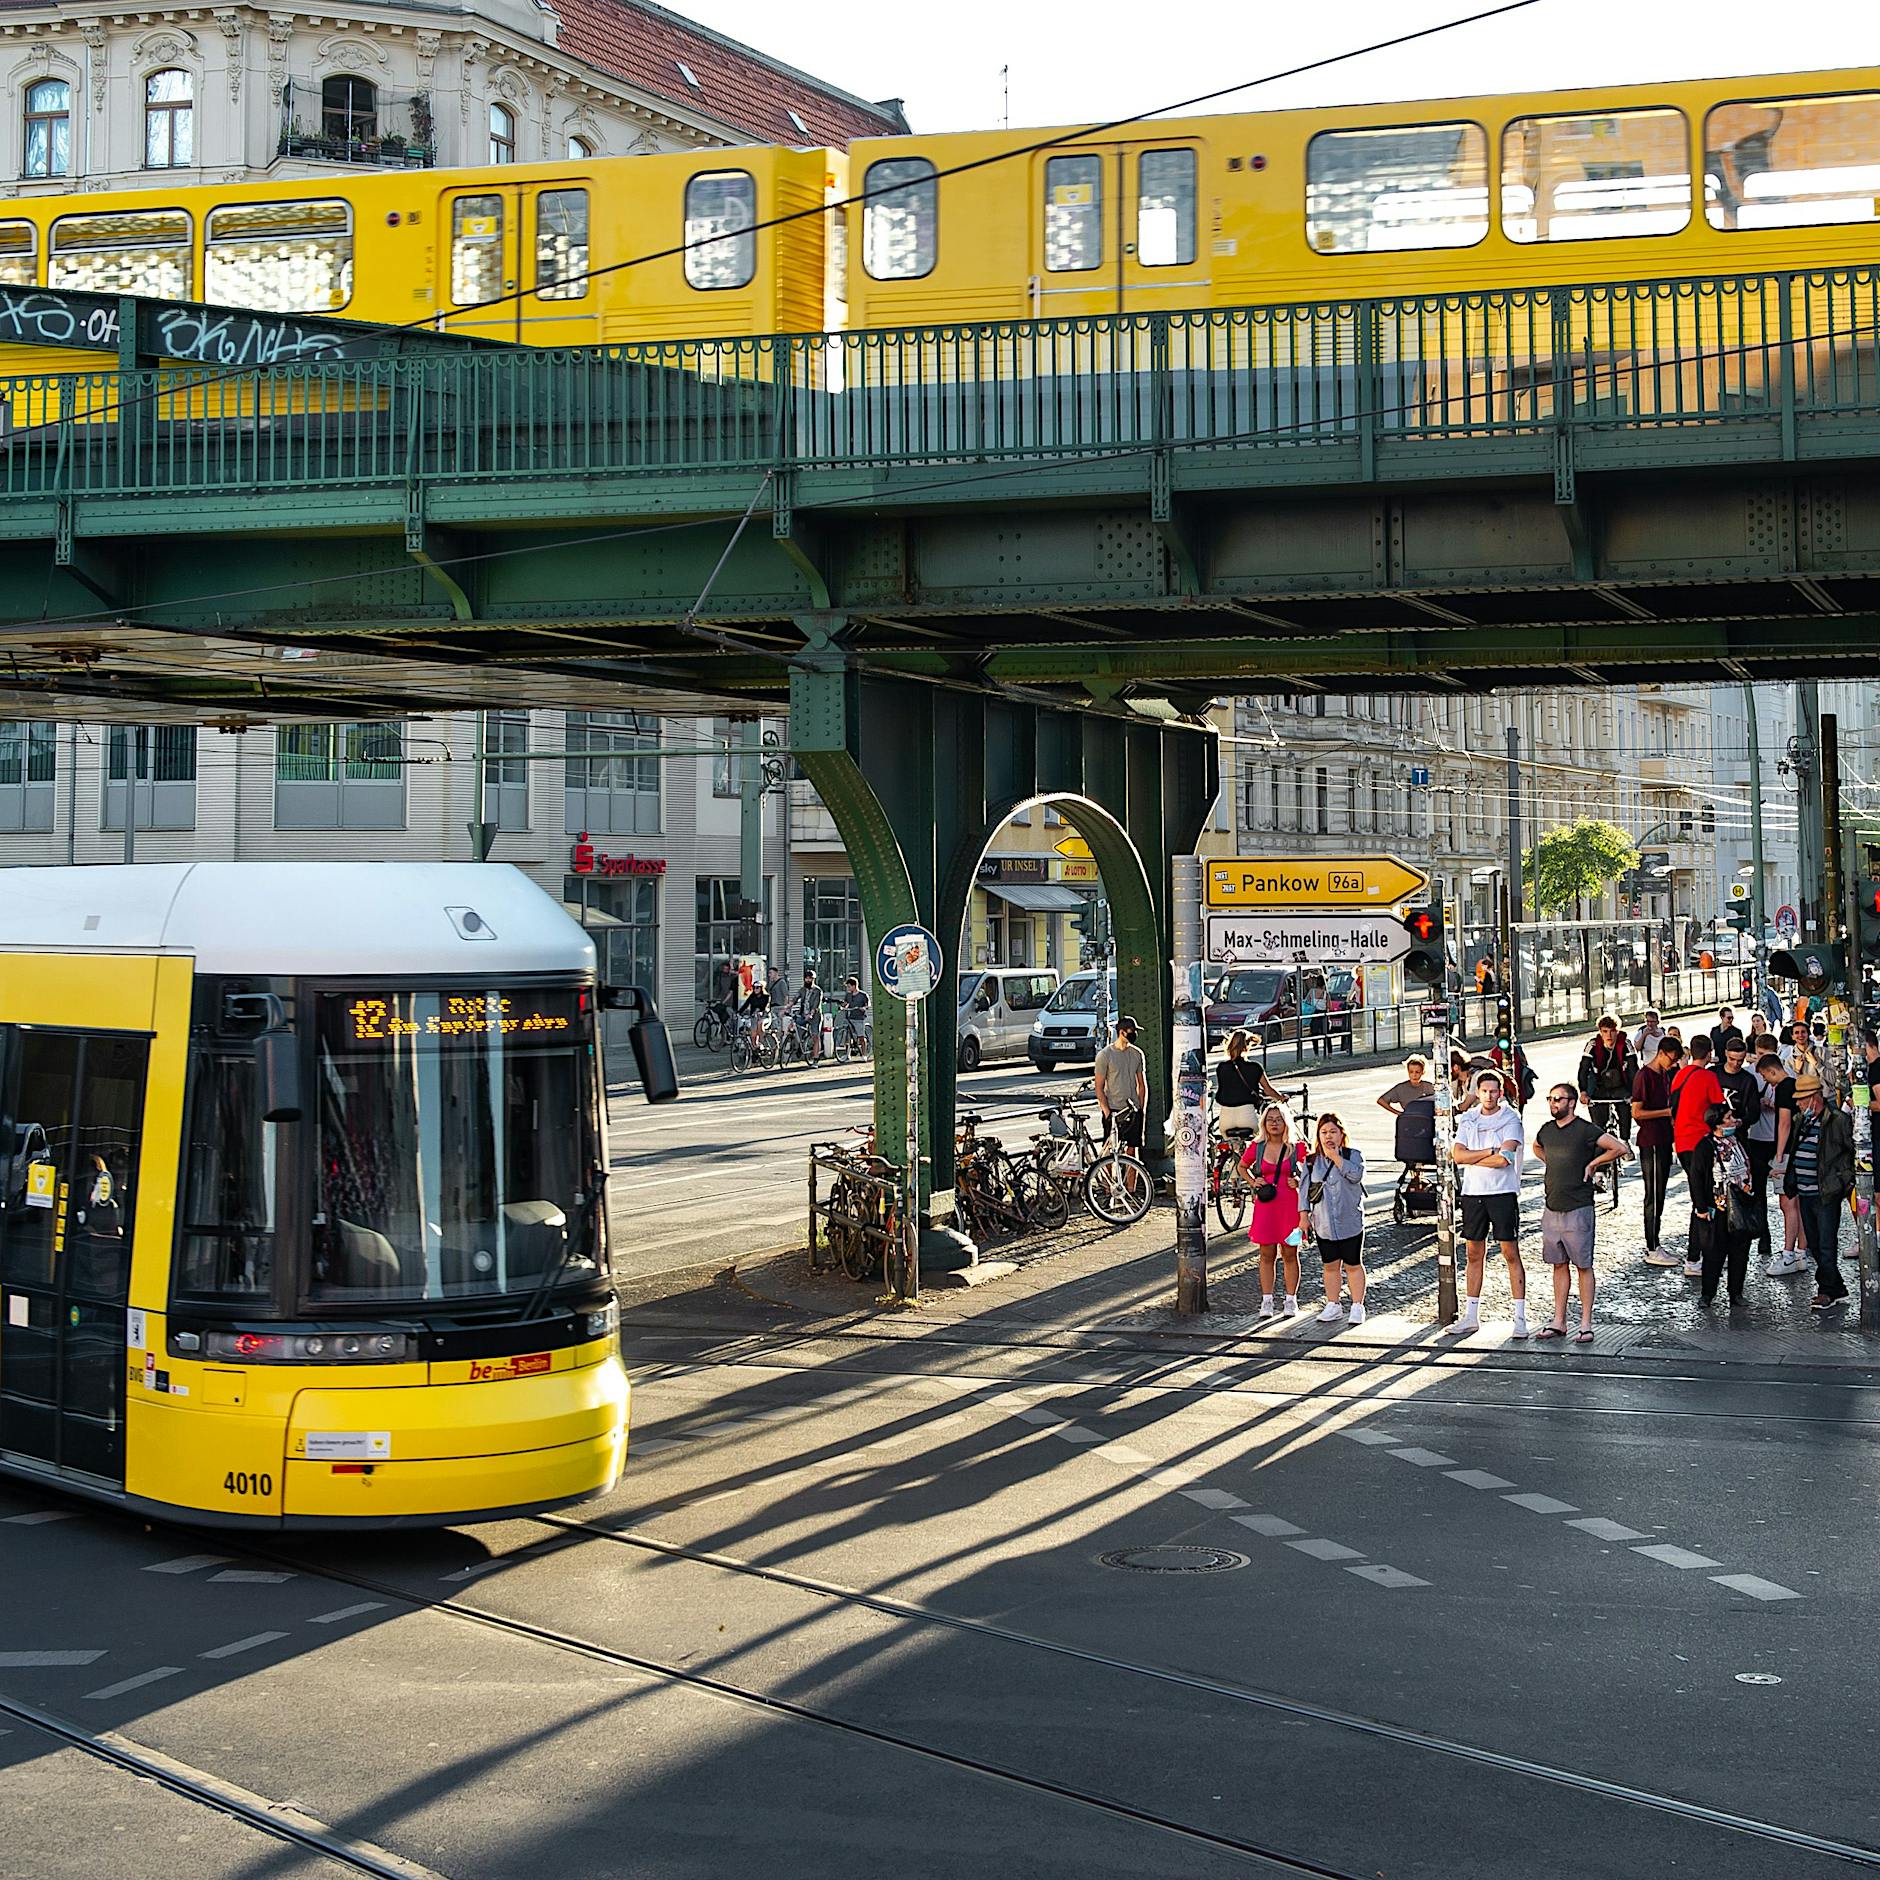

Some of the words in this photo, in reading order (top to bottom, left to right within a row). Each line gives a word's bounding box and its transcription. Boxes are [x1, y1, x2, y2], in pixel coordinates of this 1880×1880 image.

[598, 853, 667, 878] Sparkasse
[979, 863, 998, 875] sky
[1015, 860, 1038, 872] INSEL
[1242, 874, 1320, 892] Pankow
[1333, 875, 1360, 889] 96a
[1224, 930, 1389, 948] Max-Schmeling-Halle
[469, 1361, 492, 1380] be
[224, 1471, 273, 1497] 4010
